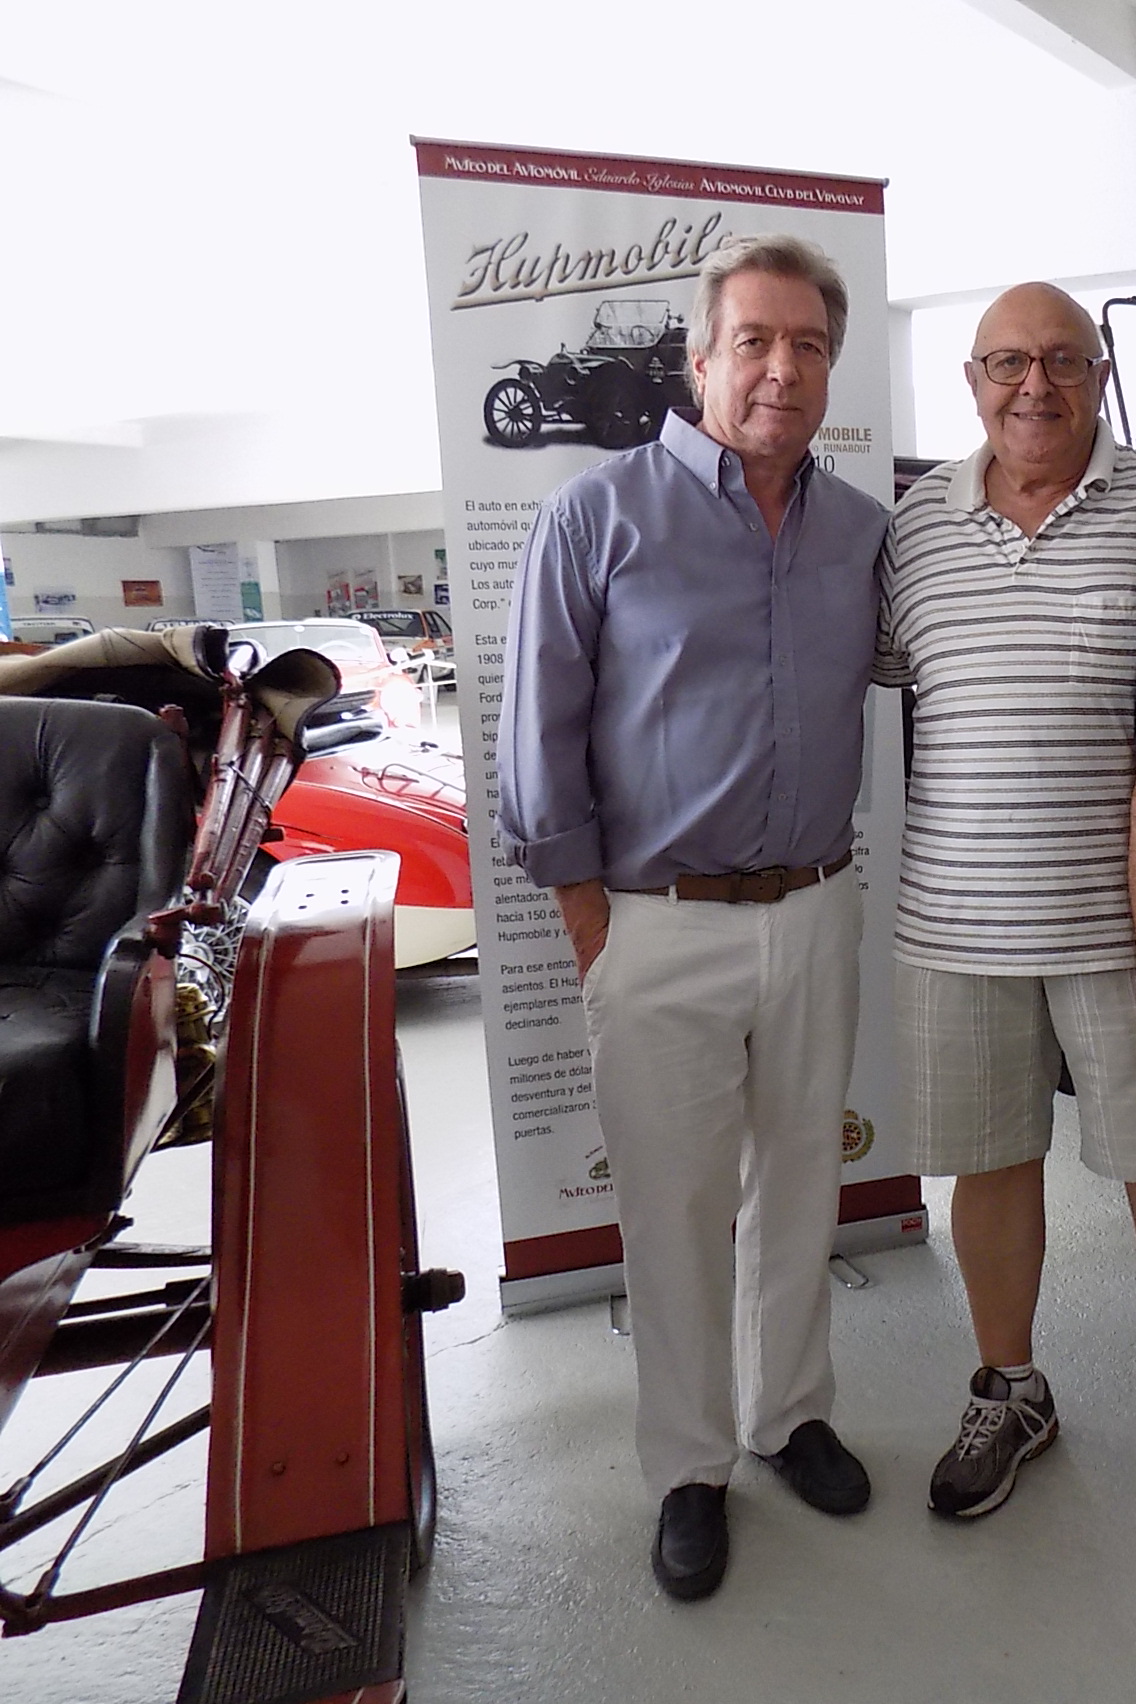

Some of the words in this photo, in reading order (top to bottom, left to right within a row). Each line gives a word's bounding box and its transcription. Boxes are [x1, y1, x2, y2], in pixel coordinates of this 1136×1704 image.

[488, 163, 511, 175] DEL
[795, 191, 817, 201] DEL
[818, 427, 872, 442] MOBILE
[823, 443, 871, 454] RUNABOUT
[815, 455, 835, 473] 10
[465, 500, 475, 511] El
[478, 501, 502, 511] auto
[504, 503, 518, 511] en
[467, 520, 518, 531] automóvil
[468, 540, 510, 551] ubicado
[470, 561, 495, 572] cuyo
[471, 580, 490, 590] Los
[493, 580, 514, 589] auto
[475, 634, 498, 645] Esta
[477, 653, 504, 665] 1908
[479, 692, 503, 703] Ford
[494, 876, 513, 887] que
[497, 911, 524, 923] hacia
[528, 910, 546, 920] 150
[498, 928, 552, 943] Hupmobile
[554, 928, 560, 938] y
[501, 964, 523, 975] Para
[527, 963, 544, 972] ese
[549, 979, 558, 988] El
[504, 997, 558, 1014] ejemplares
[508, 1055, 539, 1068] Luego
[542, 1052, 555, 1063] de
[556, 1049, 584, 1061] haber
[510, 1069, 552, 1085] millones
[554, 1068, 567, 1079] de
[569, 1065, 592, 1077] dólar
[511, 1086, 566, 1104] desventura
[568, 1088, 574, 1097] y
[512, 1102, 590, 1121] comercializaron
